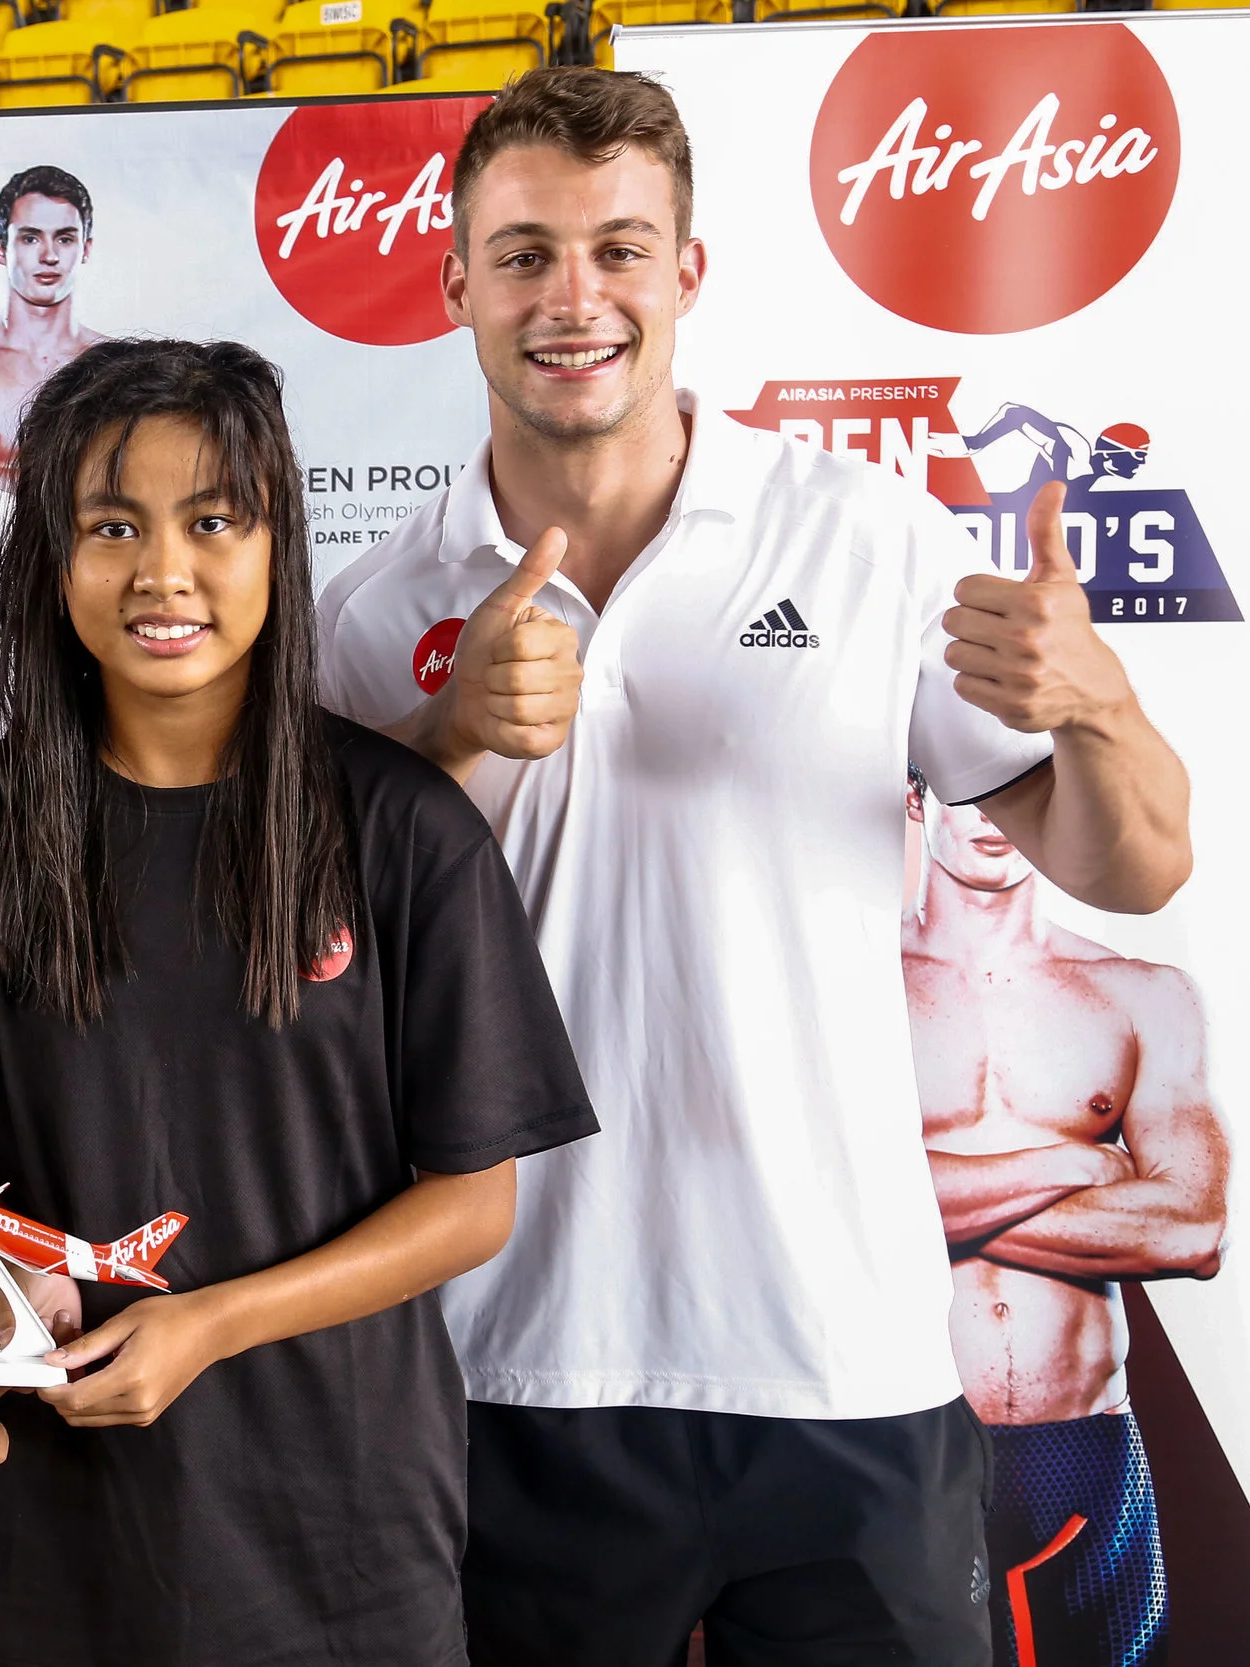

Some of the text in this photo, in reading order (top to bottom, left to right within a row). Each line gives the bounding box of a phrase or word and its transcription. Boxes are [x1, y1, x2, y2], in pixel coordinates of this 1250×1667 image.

[276, 152, 454, 259] AirAs
[778, 386, 939, 401] AIRASIA PRESENTS
[309, 464, 466, 492] EN PRO
[342, 502, 421, 521] Olympi
[315, 531, 362, 544] DARE
[1111, 597, 1188, 616] 2017
[739, 629, 820, 648] adidas
